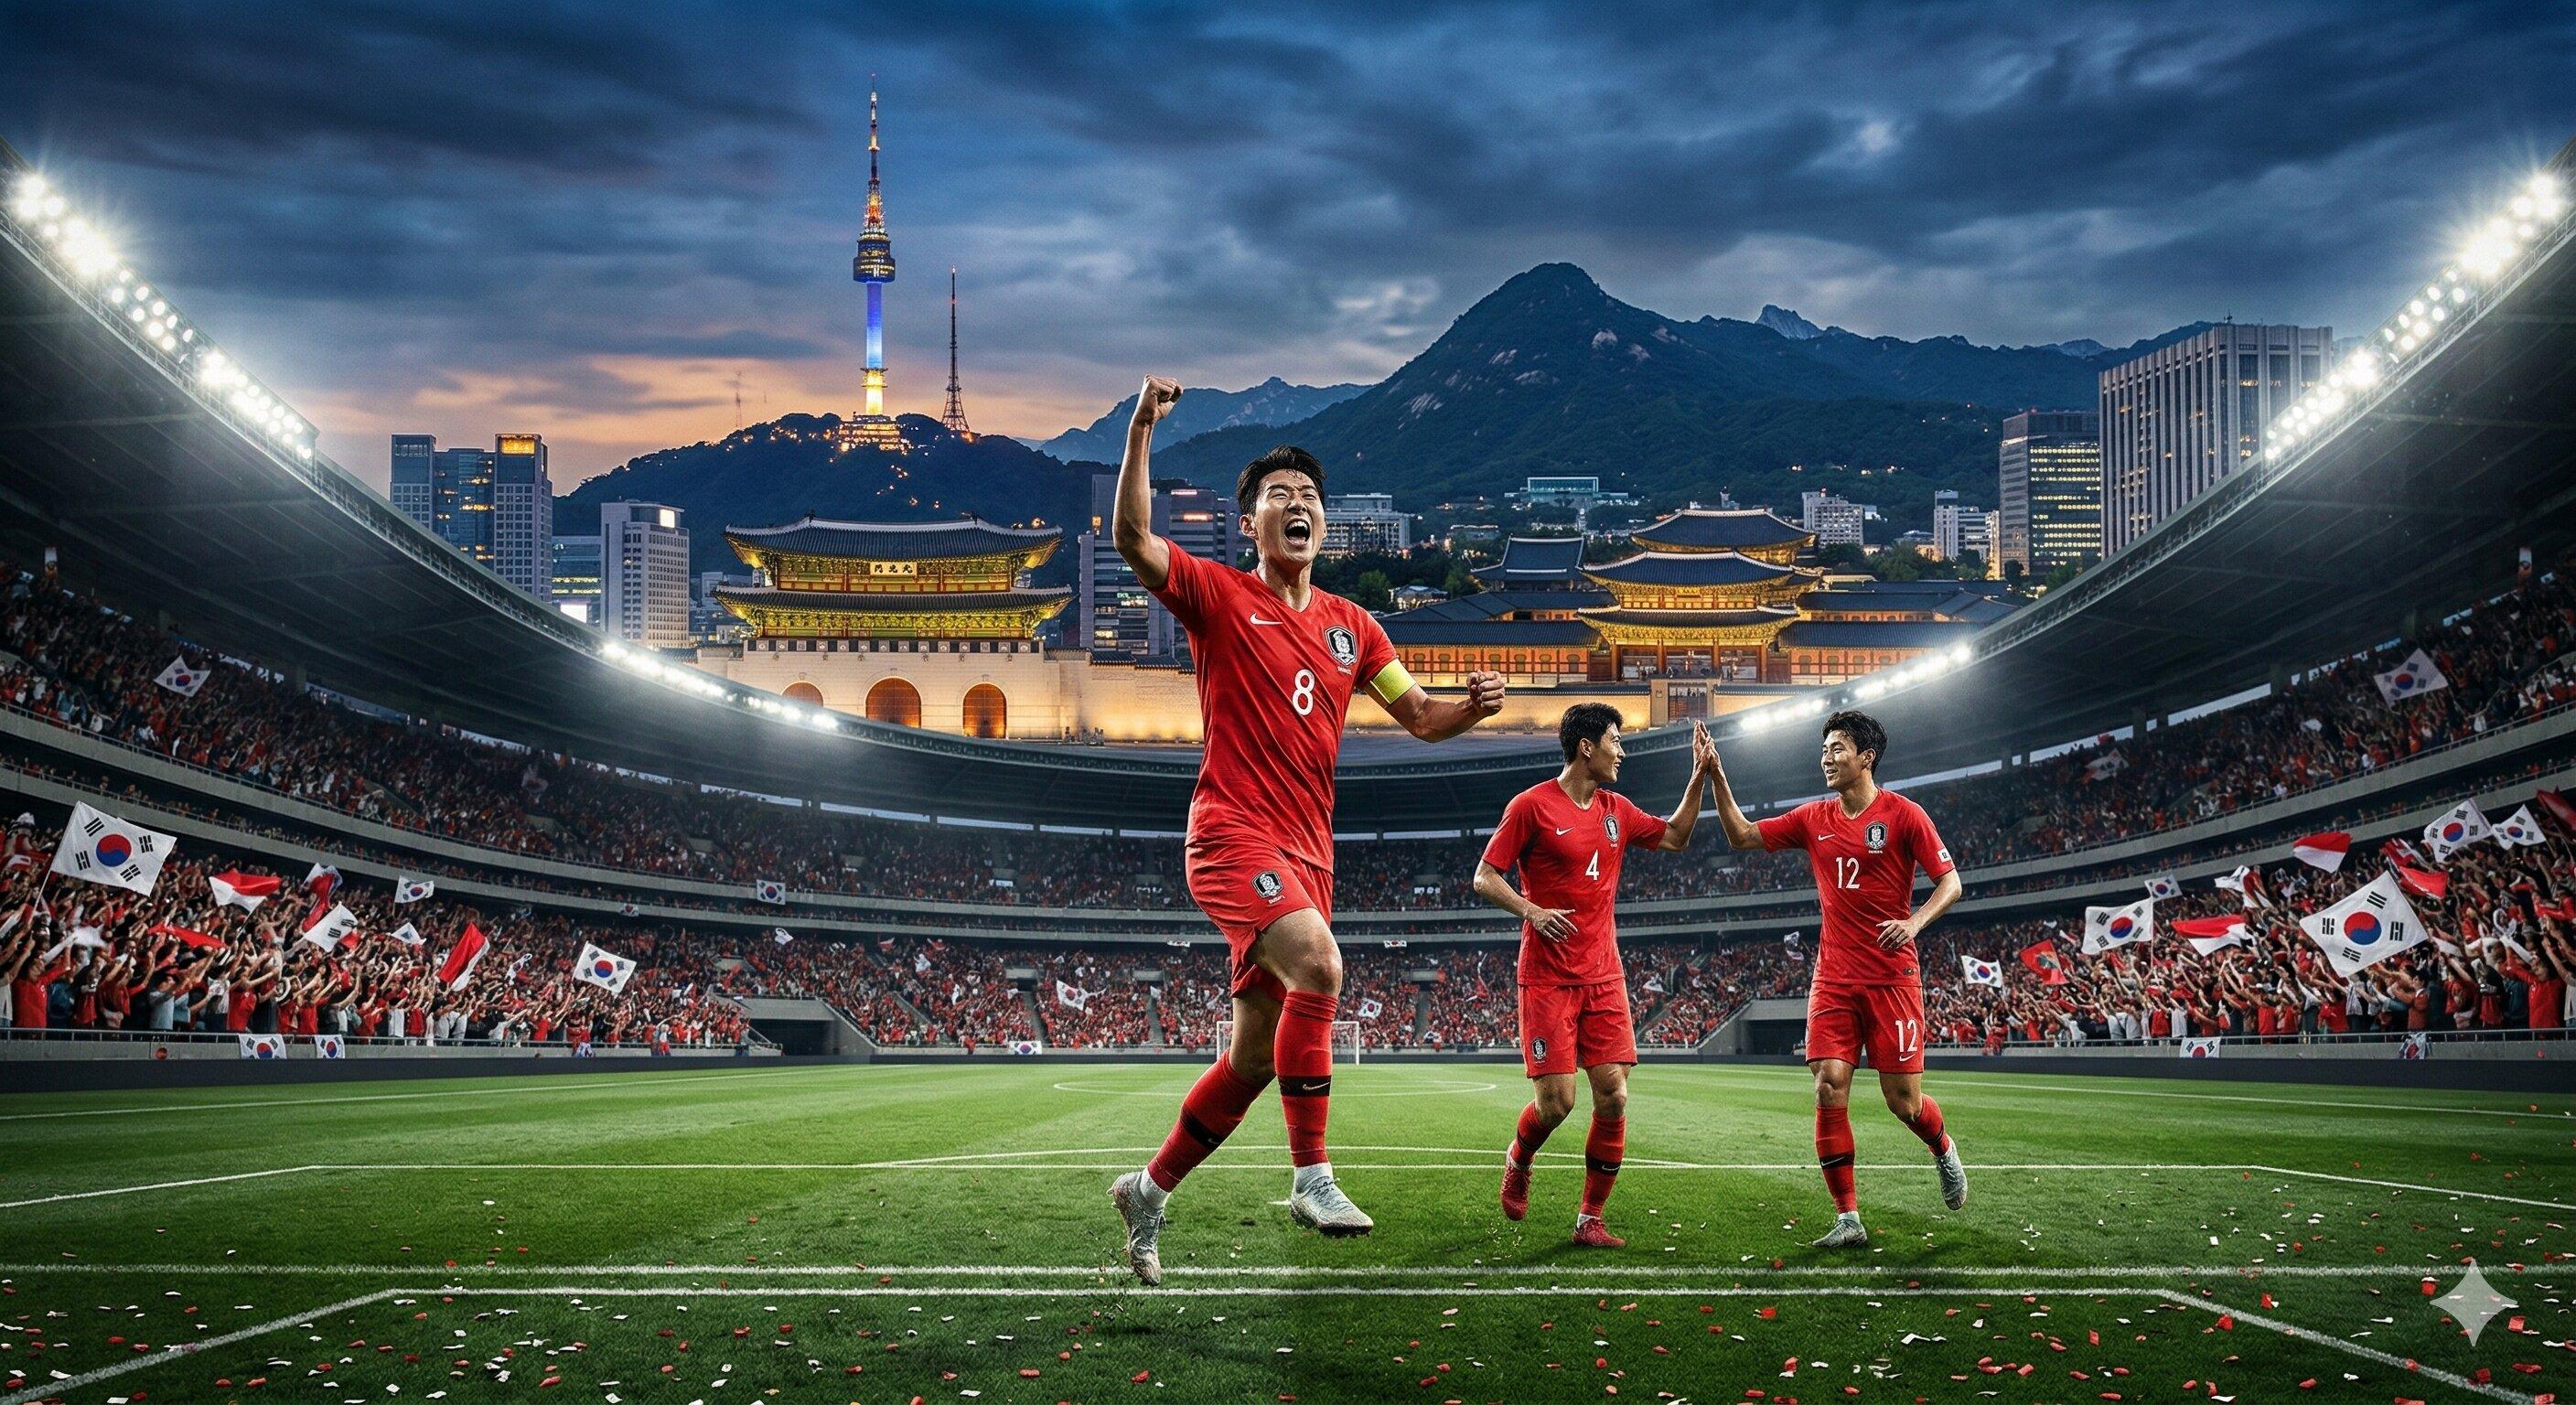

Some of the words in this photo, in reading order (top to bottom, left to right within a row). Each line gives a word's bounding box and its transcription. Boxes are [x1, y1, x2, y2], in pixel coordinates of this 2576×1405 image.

[1292, 669, 1315, 715] 8
[1585, 849, 1600, 881] 4
[1835, 856, 1861, 889] 12
[1894, 1018, 1918, 1053] 12
